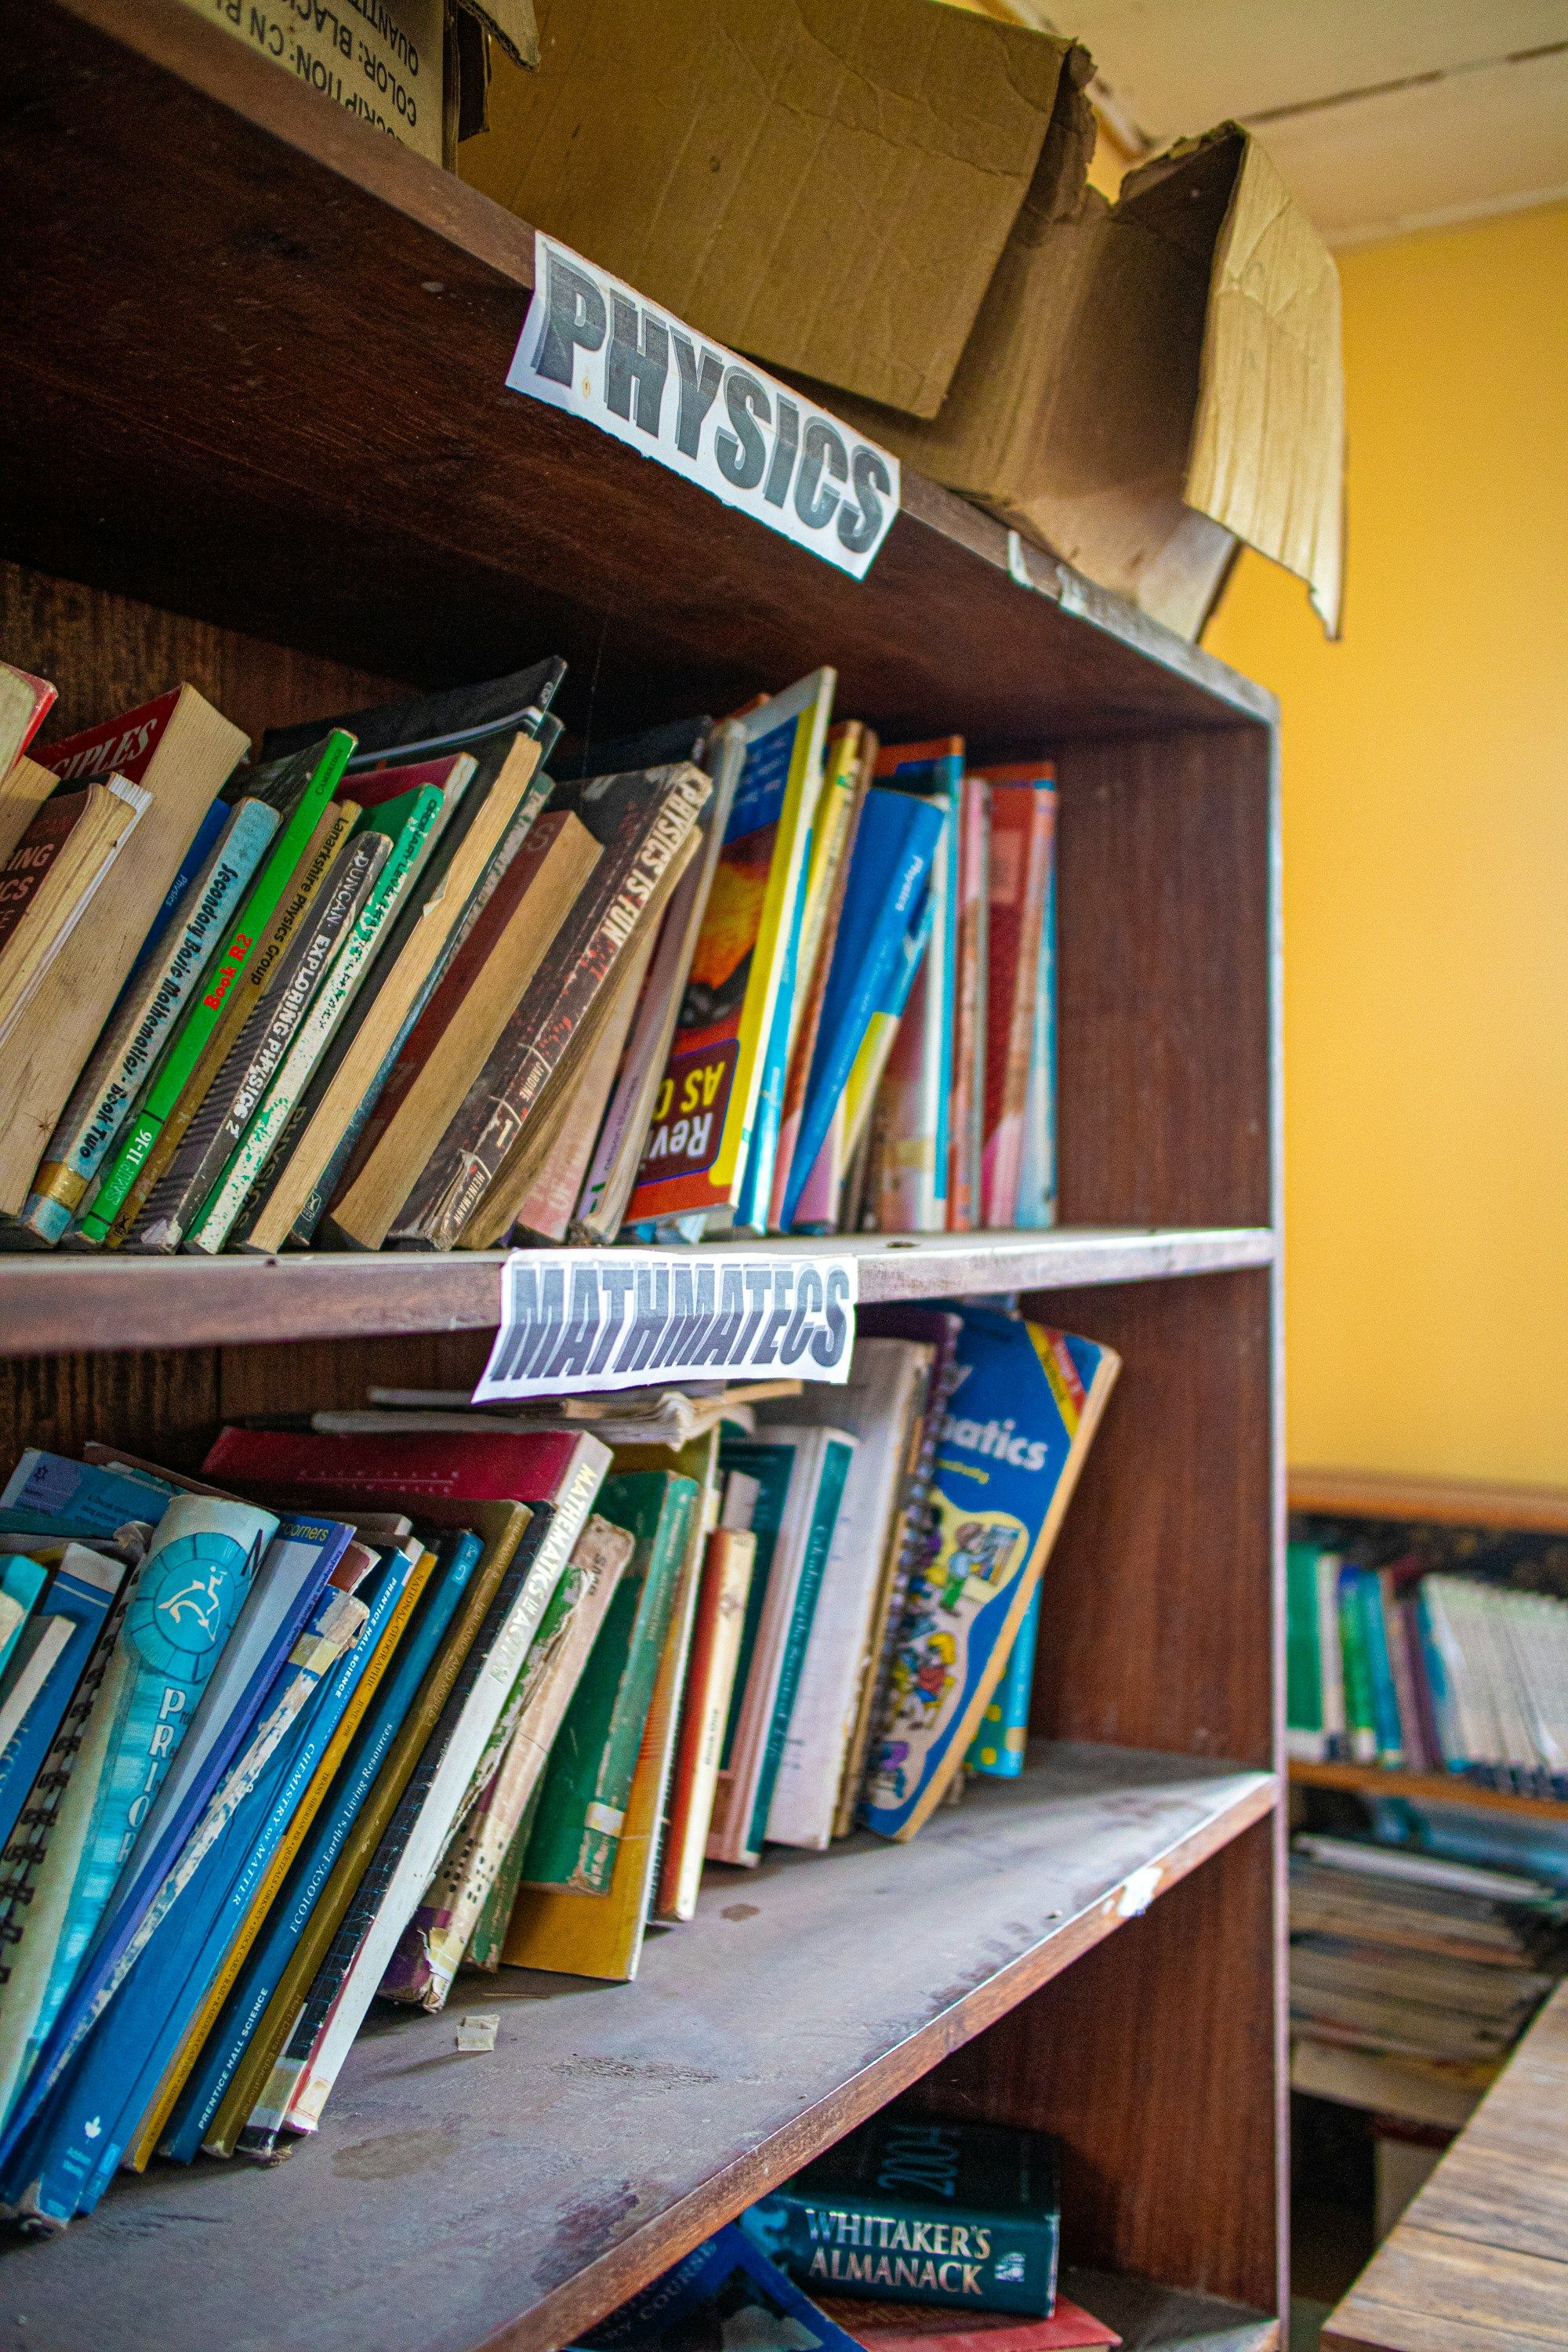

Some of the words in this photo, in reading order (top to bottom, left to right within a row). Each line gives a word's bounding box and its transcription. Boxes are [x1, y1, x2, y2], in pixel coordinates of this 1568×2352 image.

[358, 41, 417, 127] COLOR:
[530, 249, 891, 554] PHYSICS
[314, 746, 343, 796] CAMBRIDGE
[636, 779, 706, 874] PHYSICS
[300, 815, 349, 894] Lanarkshire
[162, 873, 188, 906] Physics
[184, 861, 240, 941] Secondary
[621, 867, 658, 902] IS
[272, 892, 307, 944] Physics
[596, 892, 643, 947] FUN
[168, 937, 201, 980] Basic
[202, 957, 237, 1011] Book
[236, 933, 252, 962] R2
[247, 942, 280, 987] Group
[270, 931, 332, 1038] EXPLORING
[119, 978, 181, 1076] Mathematics
[94, 1082, 128, 1125] Book
[230, 1035, 284, 1121] PHYSICS
[517, 1060, 546, 1102] JARDINE
[690, 1060, 727, 1113] AS
[77, 1124, 108, 1162] Two
[125, 1127, 154, 1166] 11-16
[223, 1119, 243, 1138] 2
[643, 1112, 715, 1163] Rev
[449, 1170, 487, 1224] HEINEMANN
[945, 1417, 1049, 1472] atics
[525, 1461, 600, 1599] MATHEMATICS
[369, 1577, 397, 1625] PRENTICE
[394, 1572, 424, 1624] NATIONAL
[357, 1626, 372, 1653] HALL
[363, 1624, 400, 1691] GEOGRAPHIC
[334, 1653, 360, 1698] SCIENCE
[349, 1698, 365, 1719] JUNE
[270, 1742, 317, 1826] CHEMISTRY
[300, 1770, 330, 1823] TRANS-SIBERIAN
[320, 1818, 349, 1862] Earth's
[342, 1779, 368, 1818] Living
[360, 1721, 394, 1778] Resources
[291, 1829, 302, 1842] RR
[230, 1842, 267, 1905] MATTER
[270, 1844, 295, 1886] QUETZALS
[252, 1888, 274, 1922] ORKNEY
[227, 1951, 243, 1973] CARS
[238, 1924, 256, 1951] STOCK
[196, 2071, 230, 2129] PRENTICE
[225, 2038, 244, 2068] HALL
[239, 1987, 268, 2037] SCIENCE
[805, 2209, 992, 2260] WHITAKER'S
[809, 2247, 983, 2295] ALMANACK
